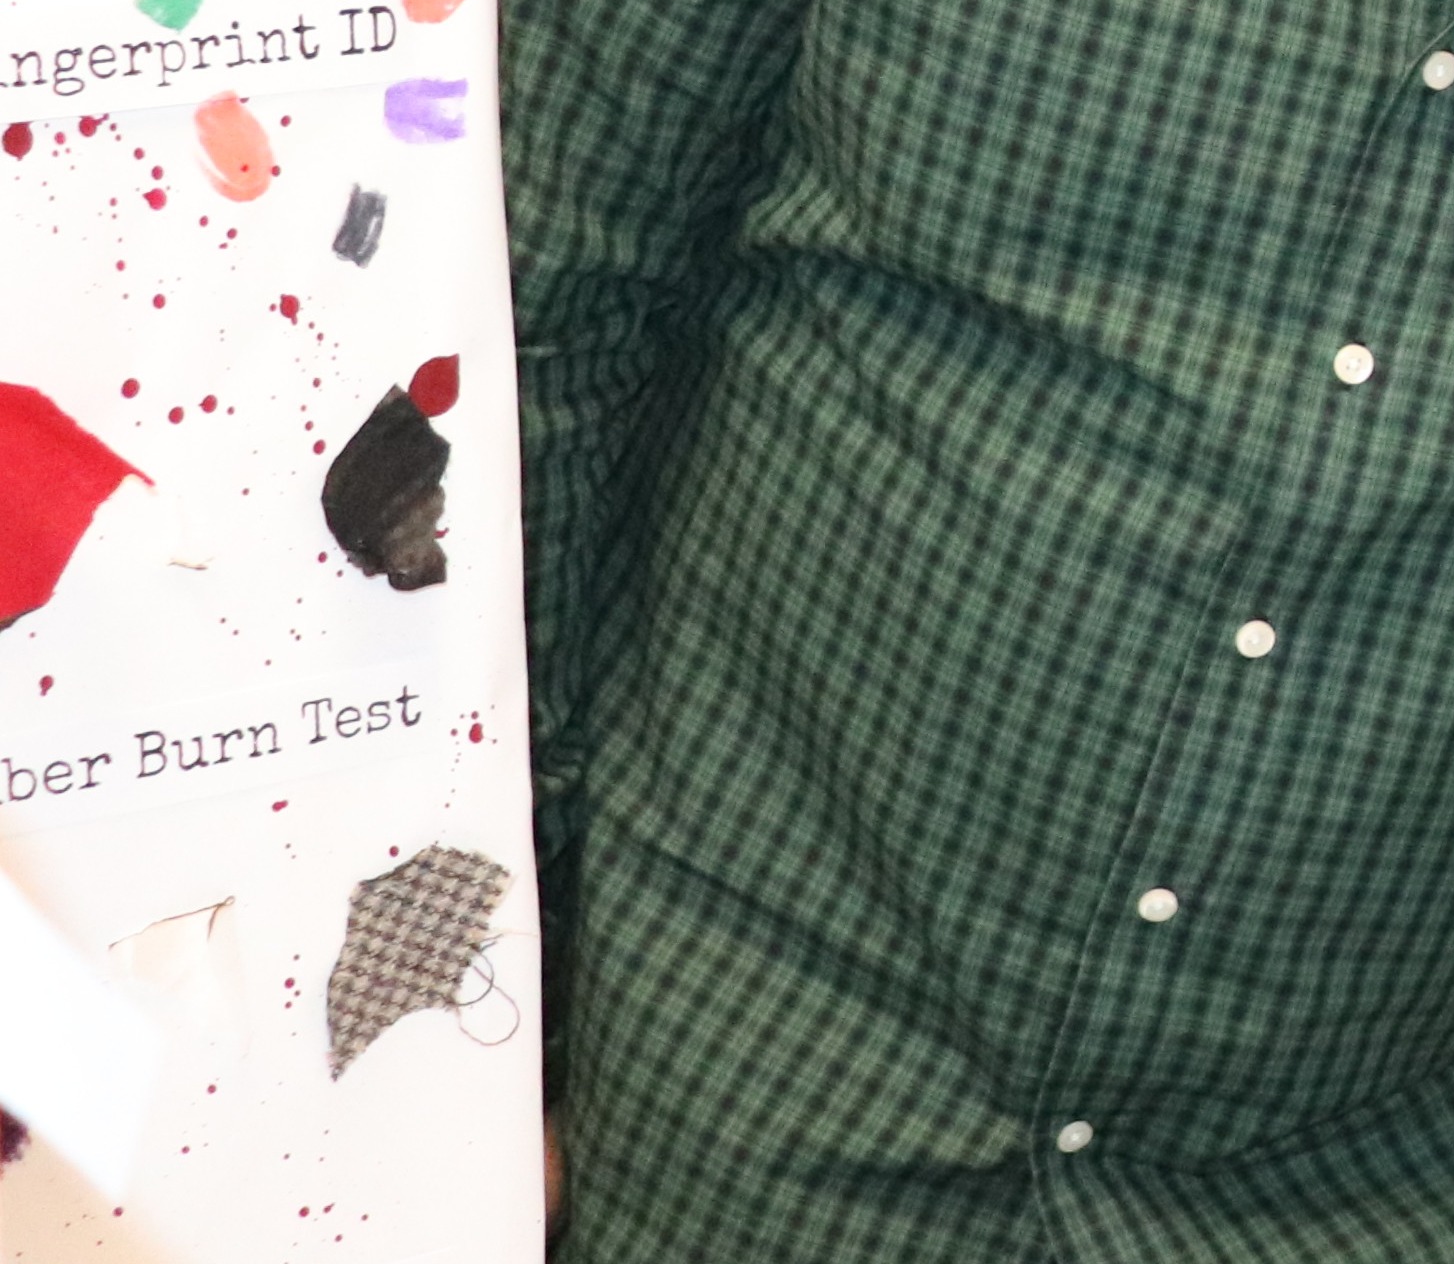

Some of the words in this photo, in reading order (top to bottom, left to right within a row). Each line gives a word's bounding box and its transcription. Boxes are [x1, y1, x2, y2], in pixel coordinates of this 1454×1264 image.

[0, 14, 319, 96] ngerprint
[338, 5, 397, 56] ID
[0, 751, 112, 805] ber
[135, 721, 282, 778] Burn
[301, 685, 421, 744] Test
